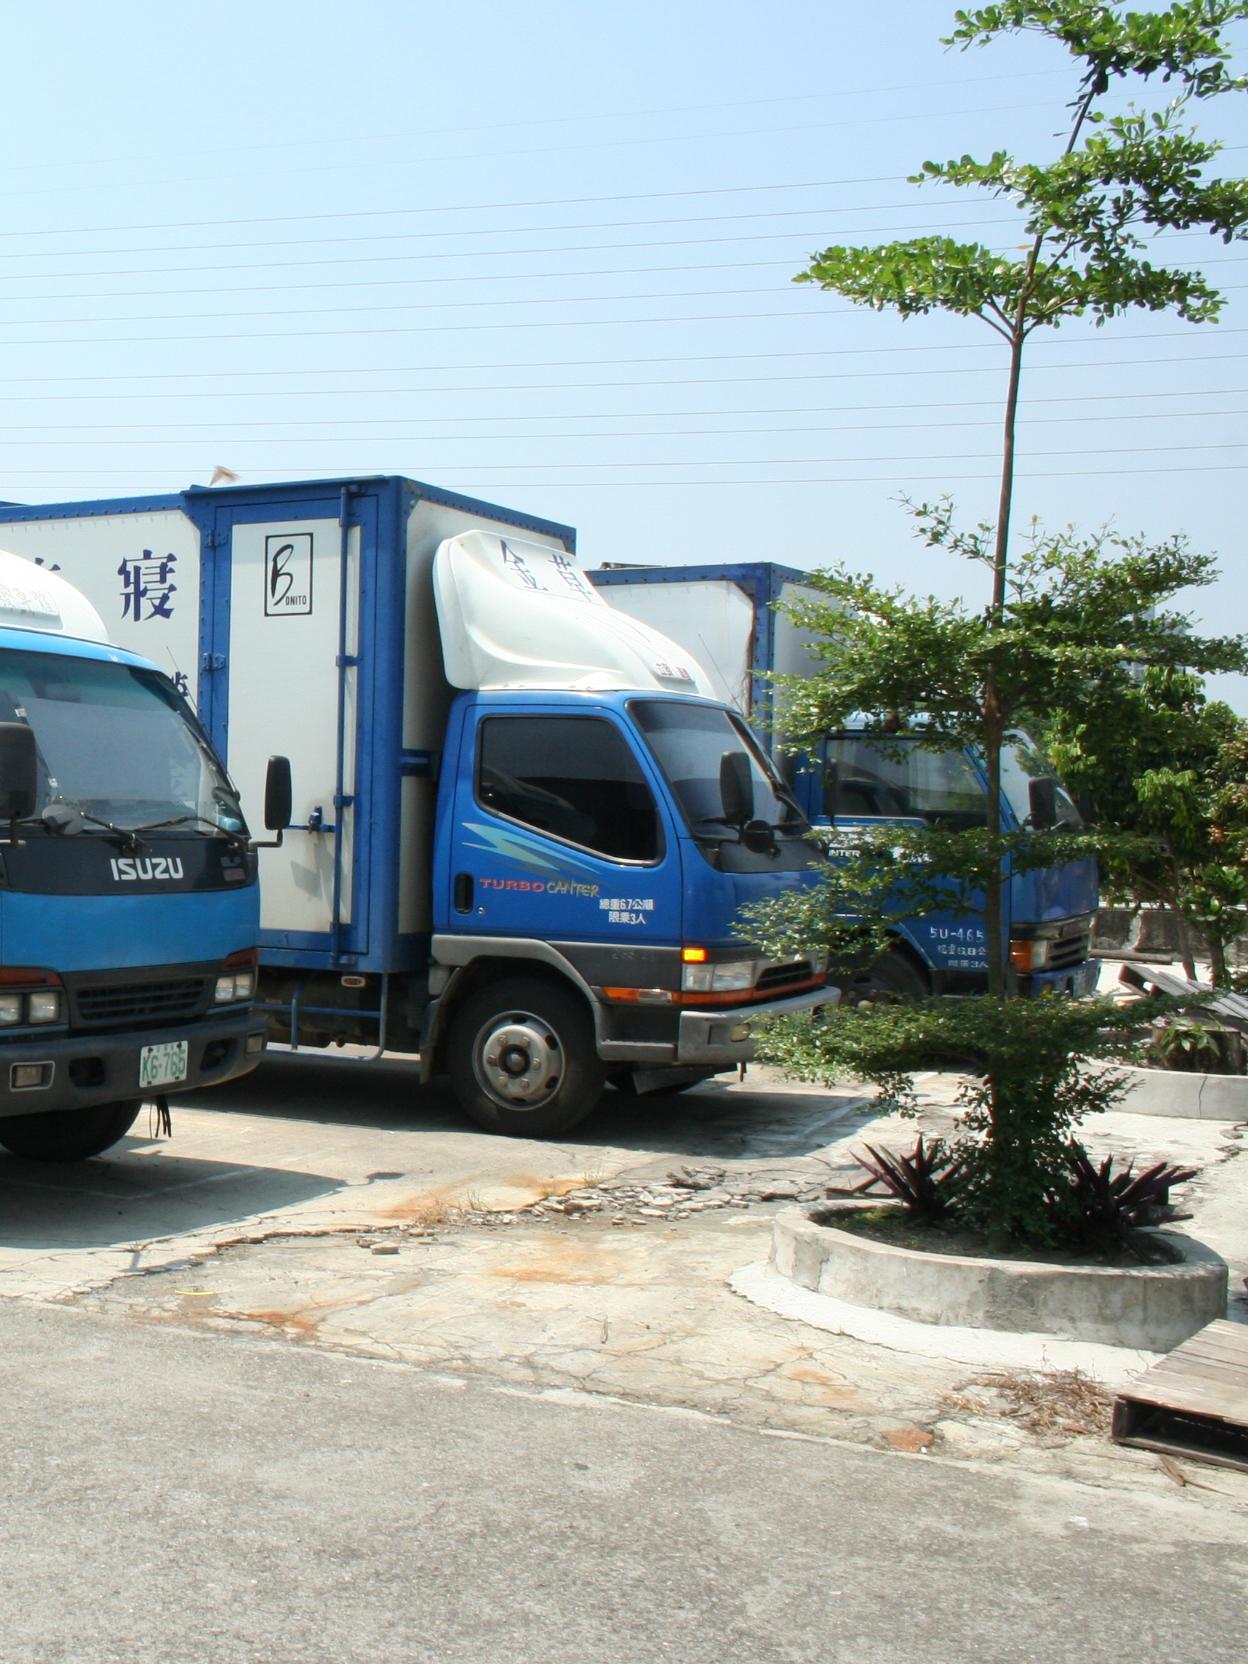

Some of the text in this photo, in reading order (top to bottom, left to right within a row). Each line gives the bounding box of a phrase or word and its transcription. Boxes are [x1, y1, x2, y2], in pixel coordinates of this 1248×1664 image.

[110, 857, 184, 881] ISUZU
[480, 878, 600, 898] TURBO CANTER
[929, 926, 985, 943] 5U-465
